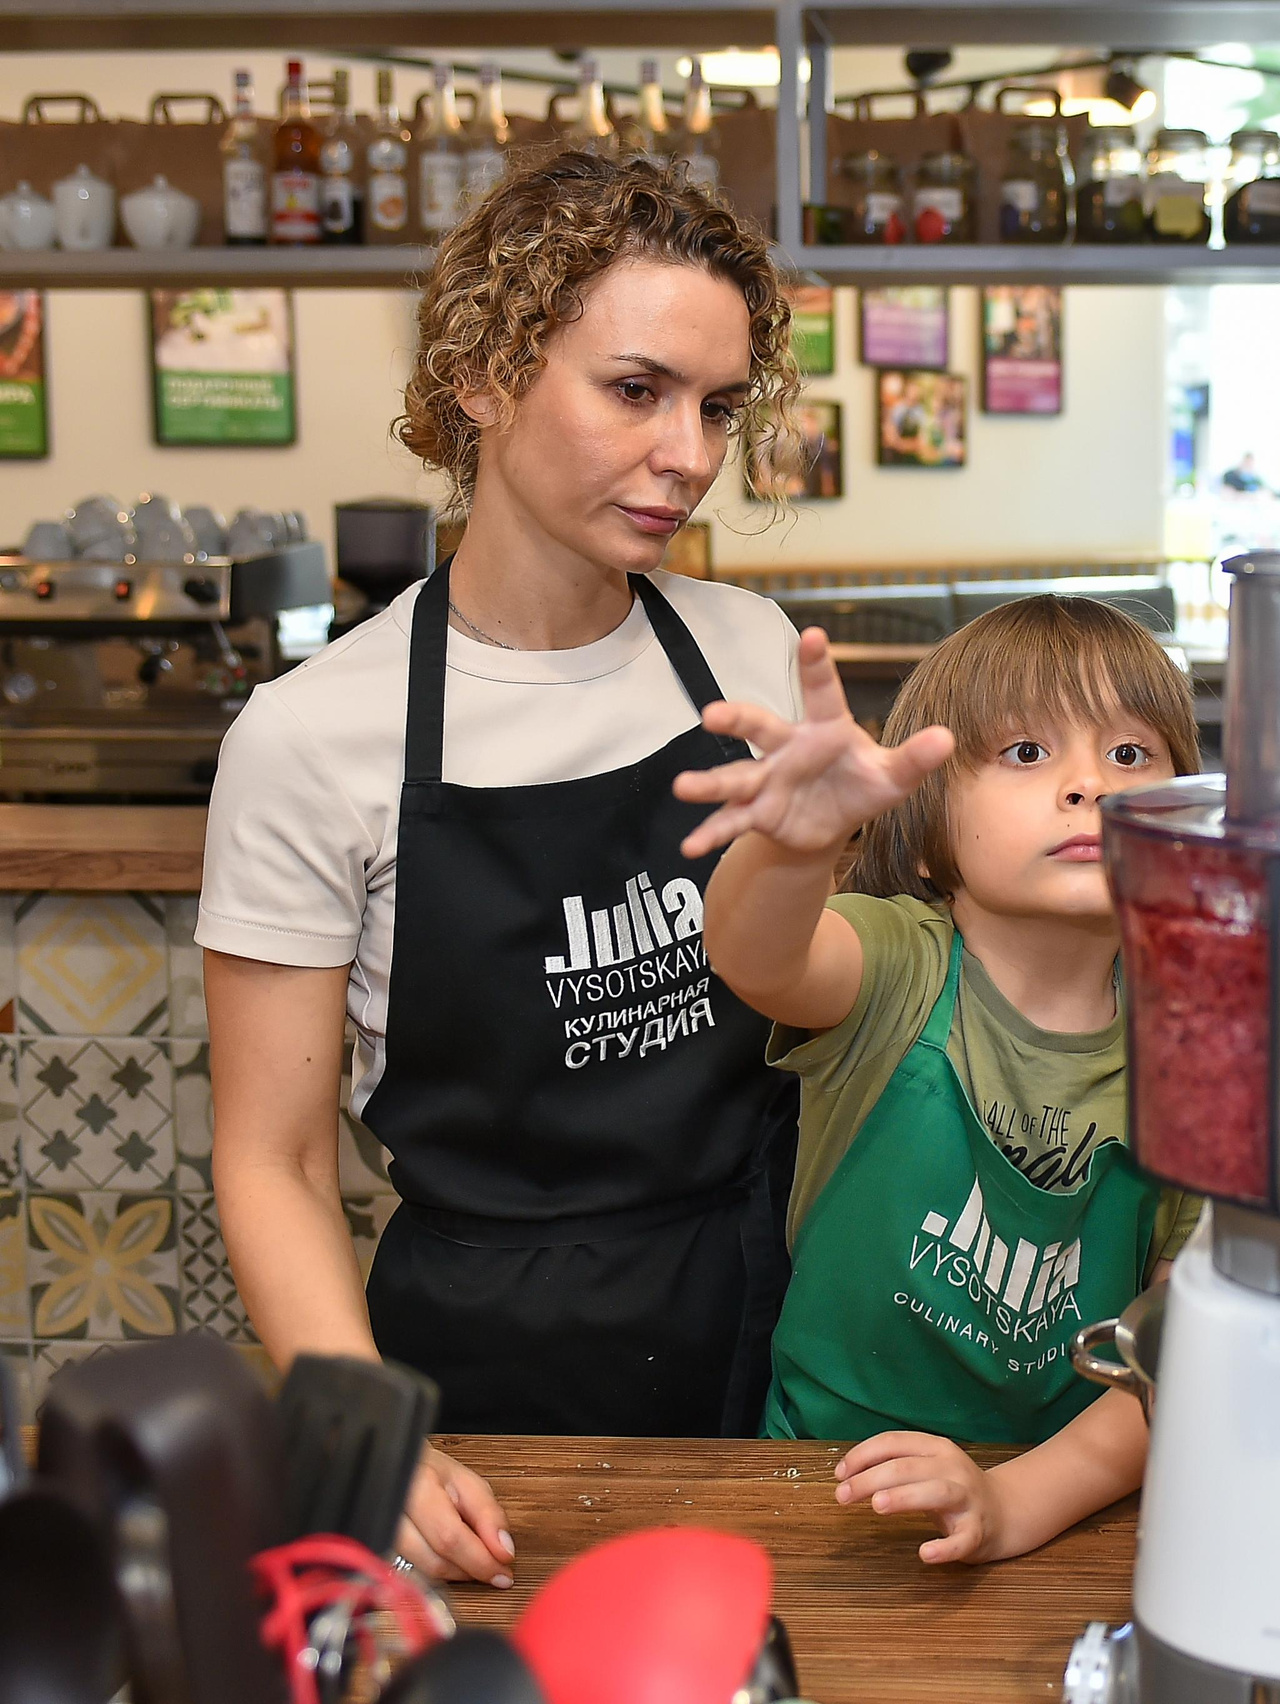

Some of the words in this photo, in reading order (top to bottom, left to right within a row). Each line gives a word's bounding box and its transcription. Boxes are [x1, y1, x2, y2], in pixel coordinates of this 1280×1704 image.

[544, 871, 704, 974] Julia
[564, 977, 710, 1038] КУЛИНАРНАЯ
[564, 998, 716, 1069] СТУДИЯ
[1021, 1113, 1038, 1135] OF
[1039, 1105, 1071, 1146] THE
[921, 1172, 1081, 1315] Julia
[909, 1235, 1082, 1343] VYSOTSKAYA
[893, 1292, 999, 1354] CULINARY
[1008, 1343, 1066, 1375] STUDI
